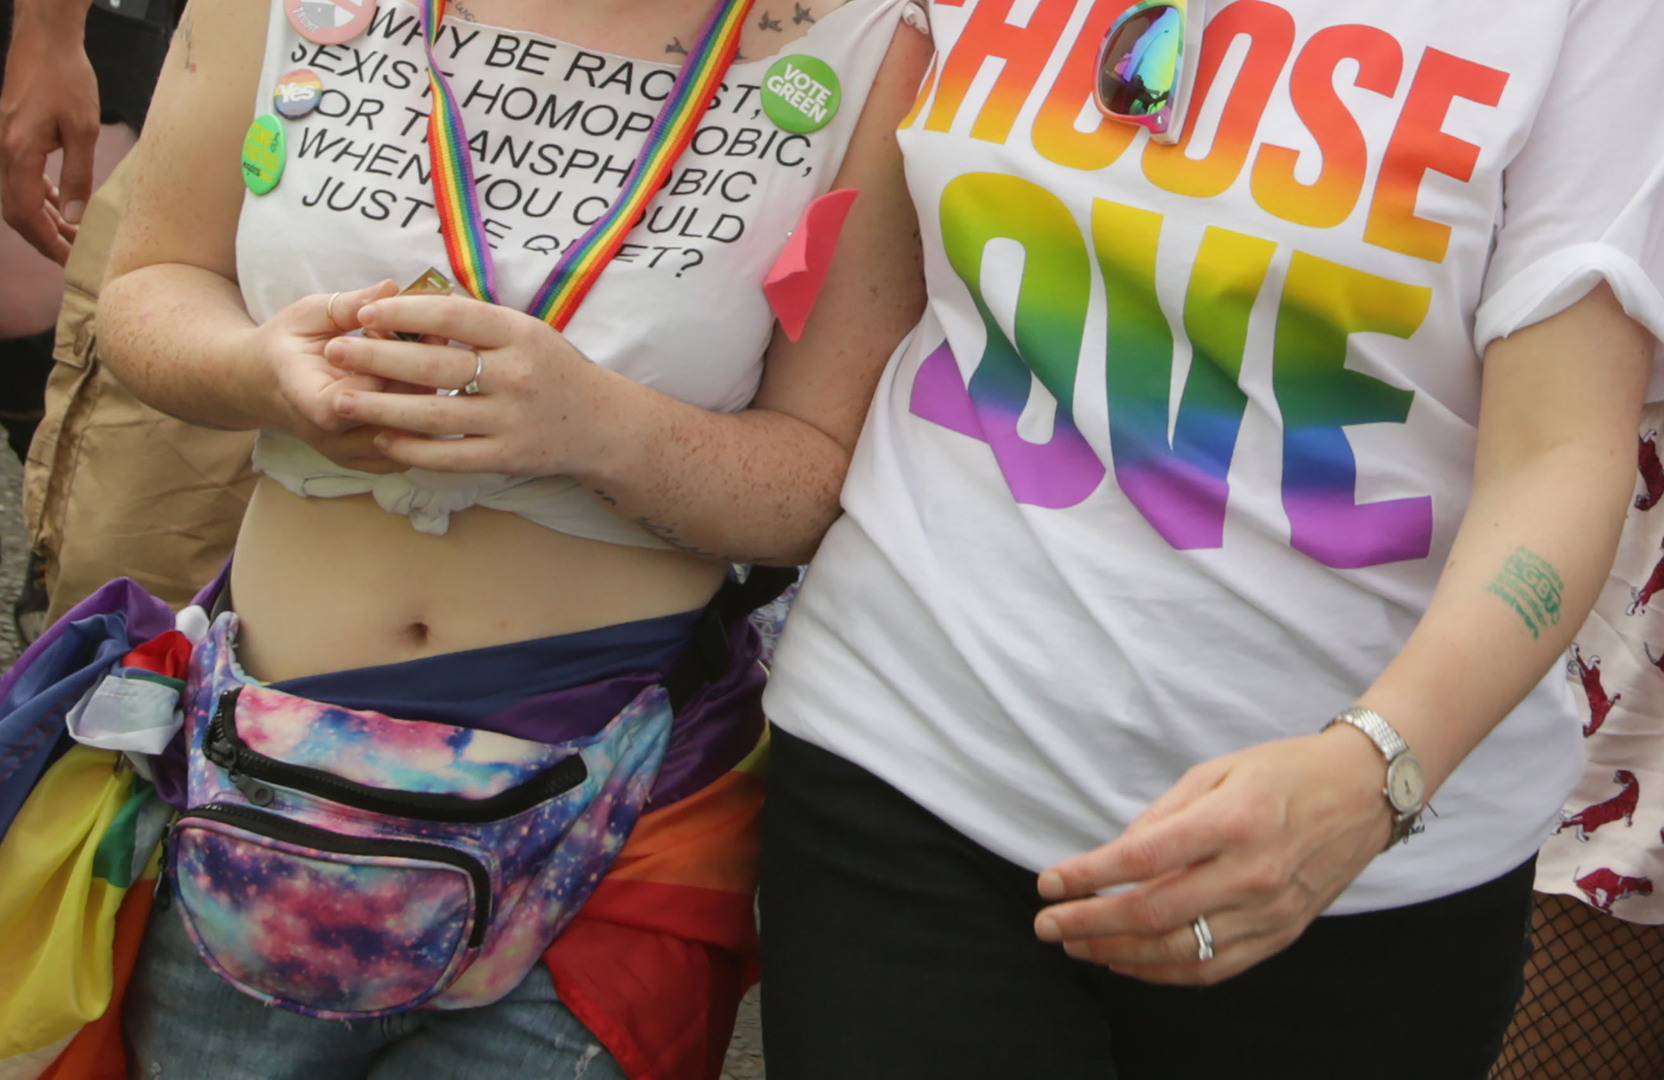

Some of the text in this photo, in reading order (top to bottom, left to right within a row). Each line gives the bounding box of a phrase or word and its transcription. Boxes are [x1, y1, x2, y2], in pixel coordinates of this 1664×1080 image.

[484, 33, 557, 76] BE
[766, 75, 828, 124] GREEN
[783, 62, 832, 107] VOTE
[315, 88, 757, 203] OR TANSPHBIC
[461, 78, 812, 177] HOMOPOBIC,
[298, 127, 432, 186] WHEN
[302, 176, 435, 228] JUST
[521, 233, 705, 278] QET?
